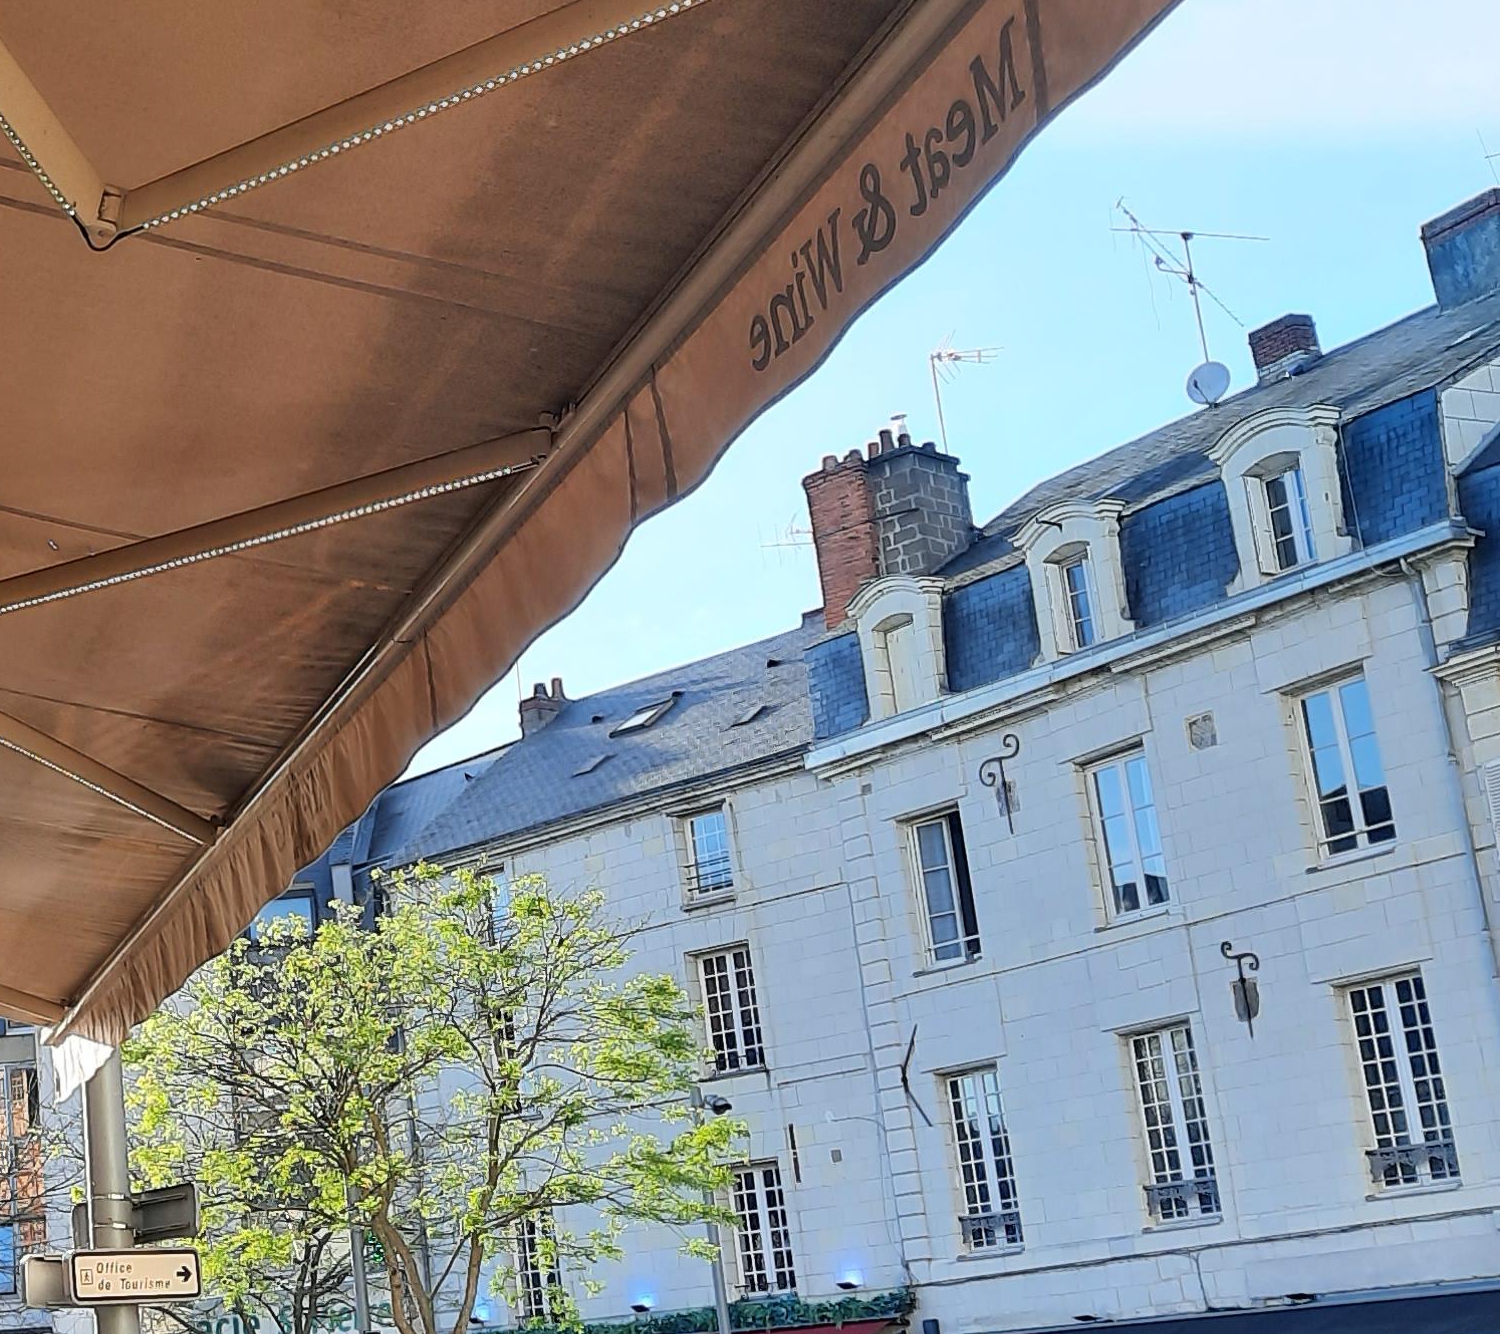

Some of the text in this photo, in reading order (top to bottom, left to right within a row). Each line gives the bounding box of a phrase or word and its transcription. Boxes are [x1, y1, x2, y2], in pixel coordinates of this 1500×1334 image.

[96, 1261, 133, 1274] Office
[98, 1277, 171, 1291] de Tourisme
